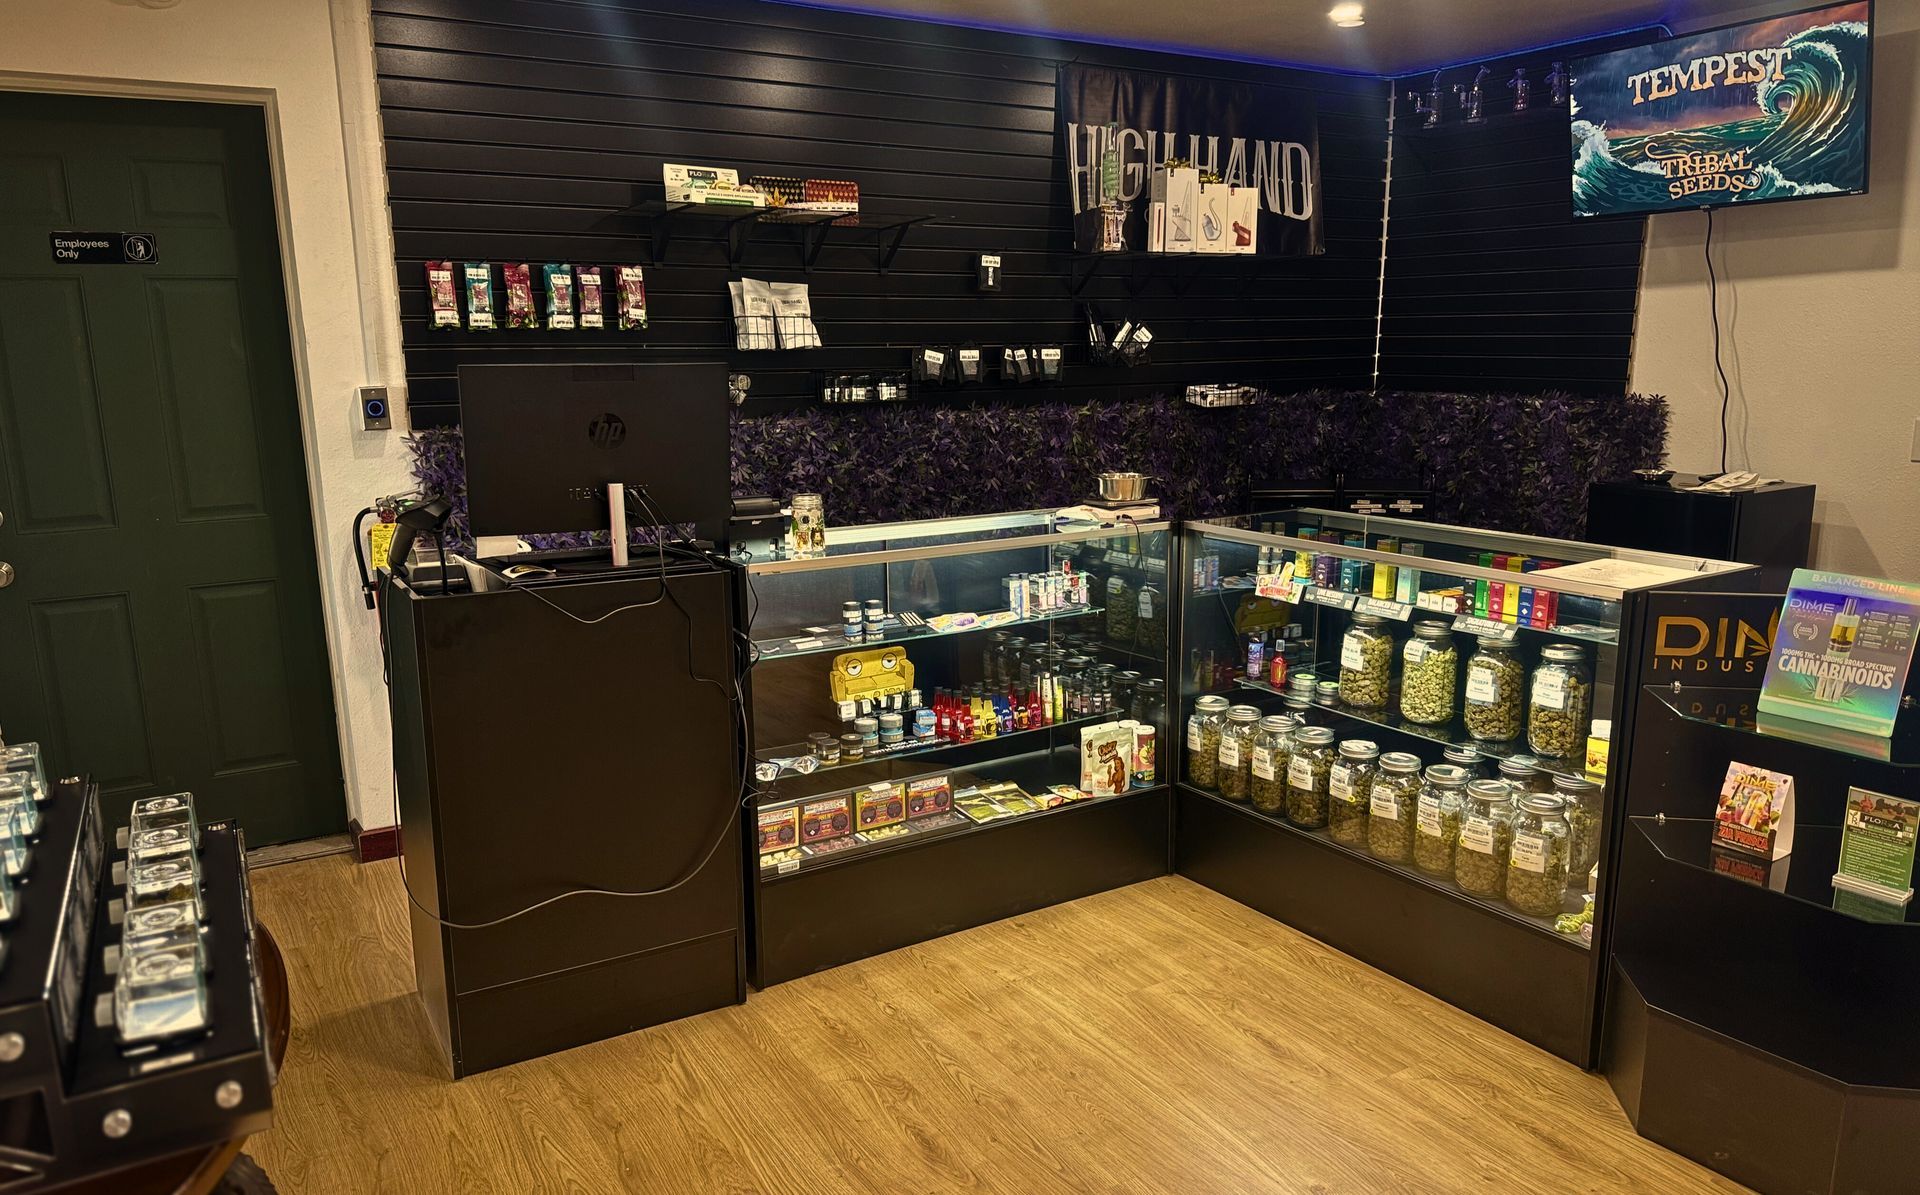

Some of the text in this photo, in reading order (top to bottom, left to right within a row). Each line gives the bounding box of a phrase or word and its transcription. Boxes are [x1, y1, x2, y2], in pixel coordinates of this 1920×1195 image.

[1627, 47, 1792, 106] TEMPEST
[1650, 147, 1752, 180] TRIBAL
[1668, 173, 1760, 200] SEEDS
[55, 239, 109, 249] Employees
[57, 249, 79, 260] Only
[1812, 574, 1877, 590] BALANCED
[1878, 583, 1906, 594] LINE
[1790, 598, 1835, 613] DIME
[1778, 655, 1894, 690] CANNABINOIDS
[1781, 648, 1804, 660] 1000MG
[1804, 651, 1816, 660] THC
[1820, 654, 1843, 665] 1000MG
[1843, 658, 1865, 668] BROAD
[1865, 662, 1897, 674] SPECTRUM
[1734, 772, 1777, 791] DIME
